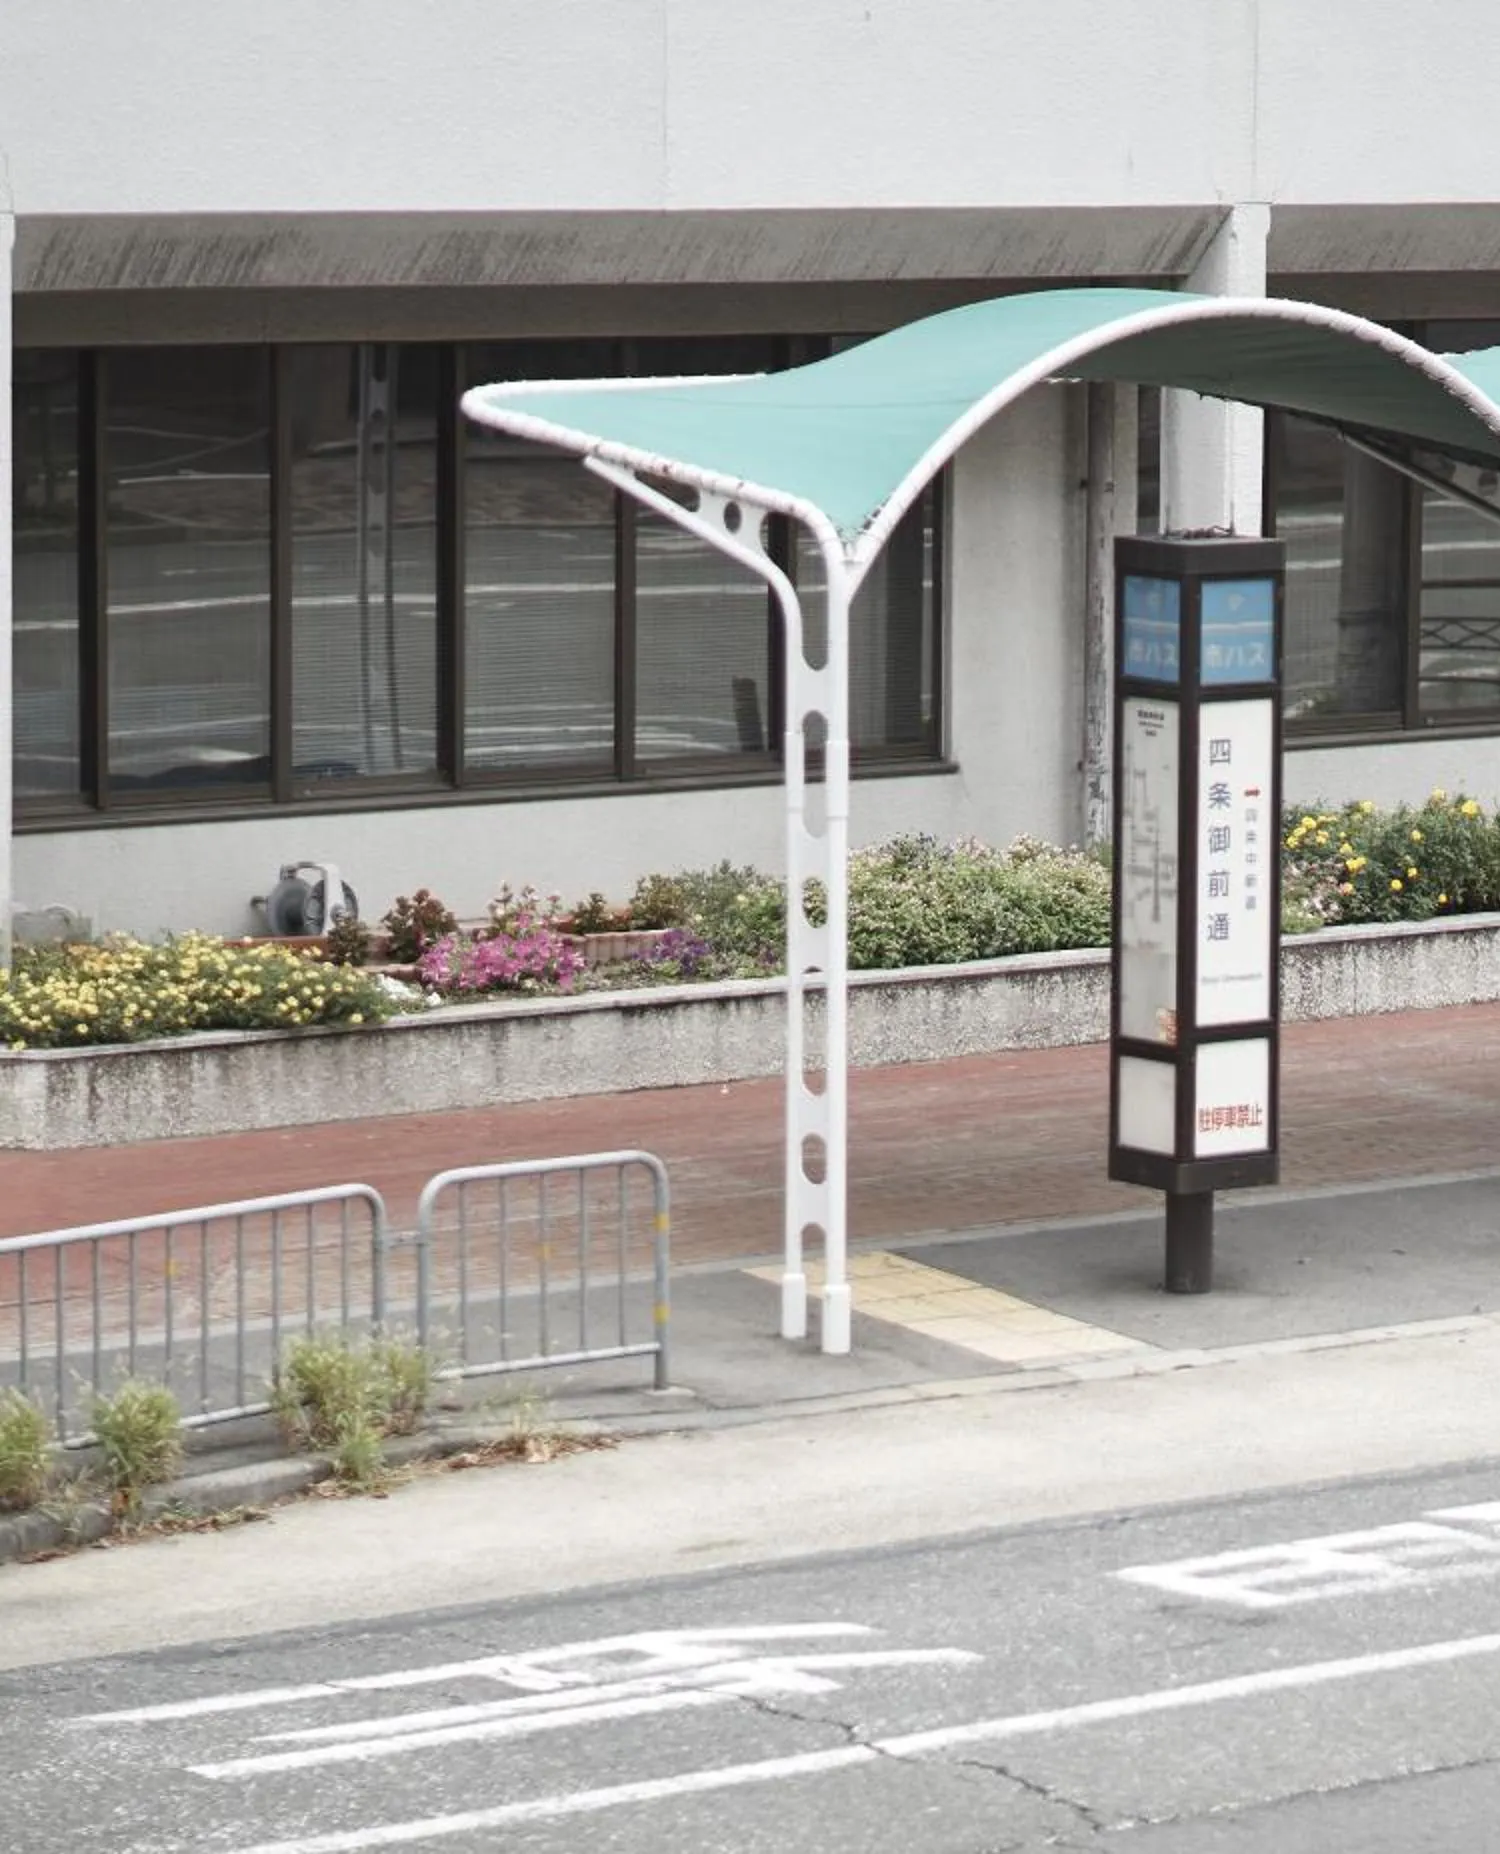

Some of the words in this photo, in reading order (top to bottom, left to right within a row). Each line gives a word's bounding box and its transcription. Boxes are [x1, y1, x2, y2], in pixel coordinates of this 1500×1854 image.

[1208, 738, 1231, 941] 四条御前通
[1199, 1102, 1263, 1132] 駐停車禁止
